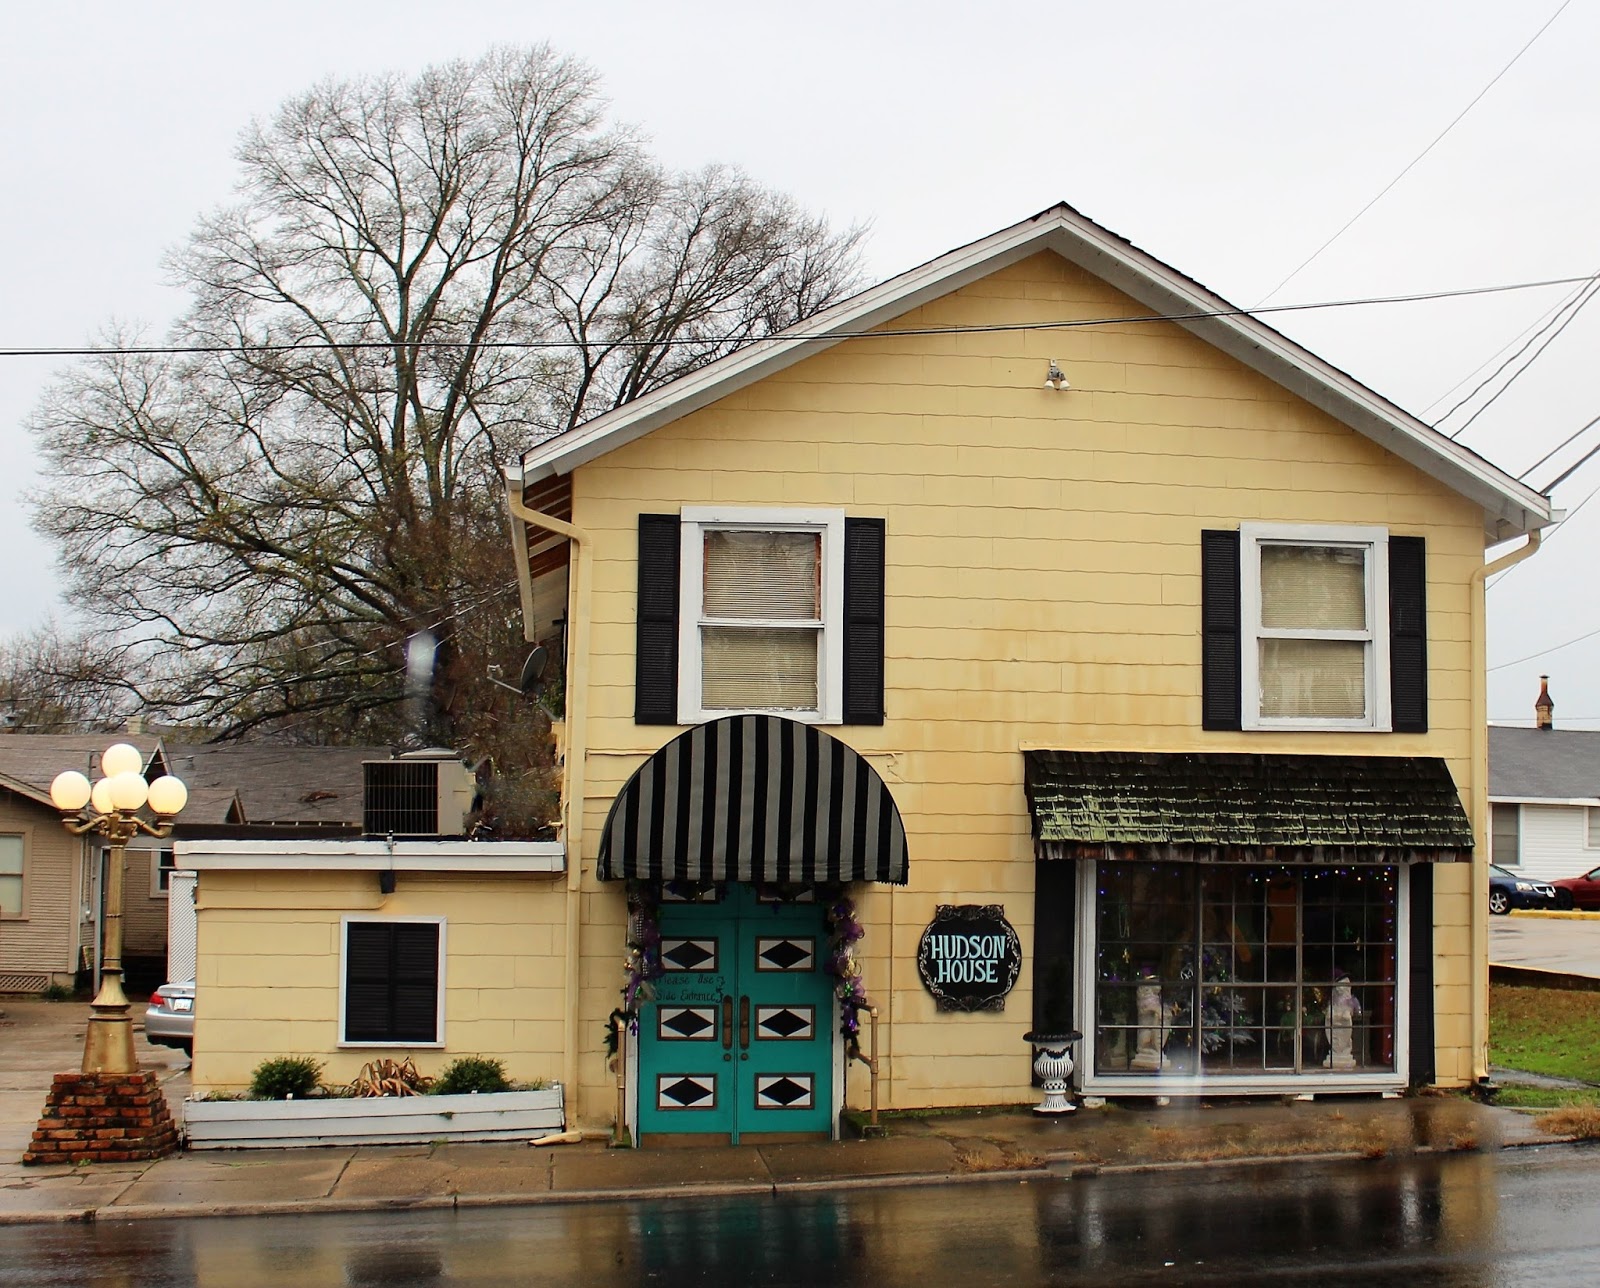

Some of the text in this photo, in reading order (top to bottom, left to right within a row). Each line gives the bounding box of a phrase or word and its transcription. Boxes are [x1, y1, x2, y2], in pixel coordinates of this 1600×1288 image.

[930, 935, 1006, 959] HUDSON
[937, 960, 998, 983] HOUSE
[656, 989, 716, 1002] Side Entrance
